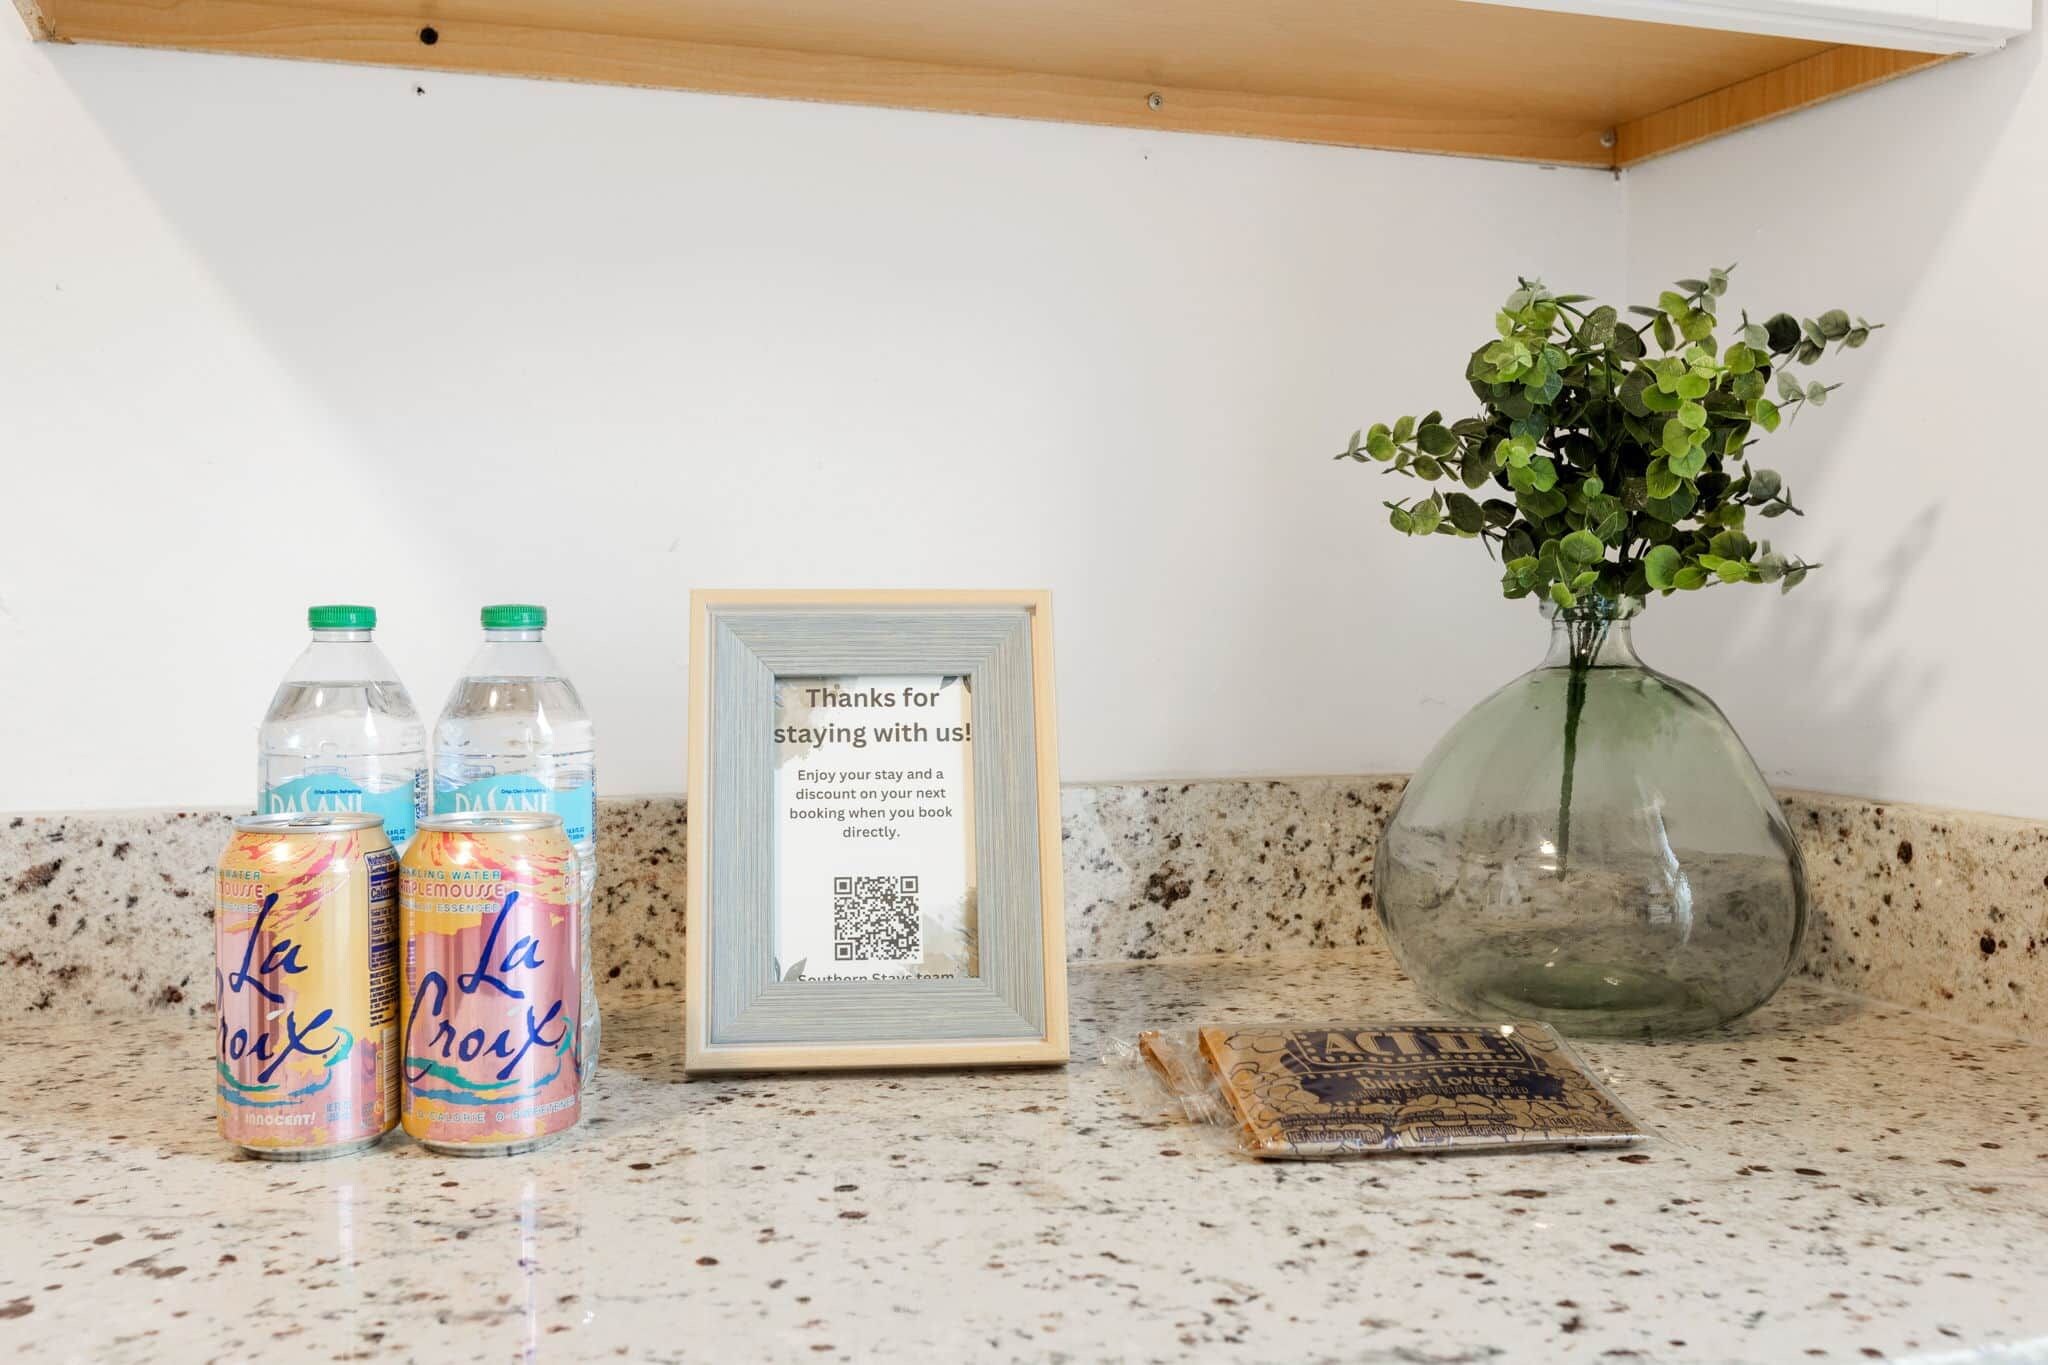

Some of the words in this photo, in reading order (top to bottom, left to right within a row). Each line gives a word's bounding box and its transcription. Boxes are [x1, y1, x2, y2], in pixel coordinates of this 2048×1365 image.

[805, 687, 896, 708] Thanks
[902, 686, 941, 708] for
[773, 722, 867, 749] staying
[873, 721, 928, 743] with
[936, 722, 971, 743] us!
[797, 768, 836, 784] Enjoy
[839, 770, 872, 784] your
[874, 769, 904, 783] stay
[906, 767, 933, 780] and
[935, 770, 945, 780] a
[795, 787, 857, 801] discount
[859, 789, 878, 800] on
[880, 788, 913, 802] your
[916, 787, 946, 799] next
[789, 807, 846, 822] booking
[848, 807, 886, 819] when
[889, 807, 915, 823] you
[918, 805, 953, 818] book
[842, 825, 901, 841] directly.
[451, 870, 501, 881] WATER
[229, 892, 308, 1004] La
[457, 890, 545, 999] La
[404, 970, 564, 1084] Croix
[1326, 1031, 1423, 1055] ACT
[1357, 1076, 1430, 1090] Butter
[1432, 1074, 1511, 1087] Lovers
